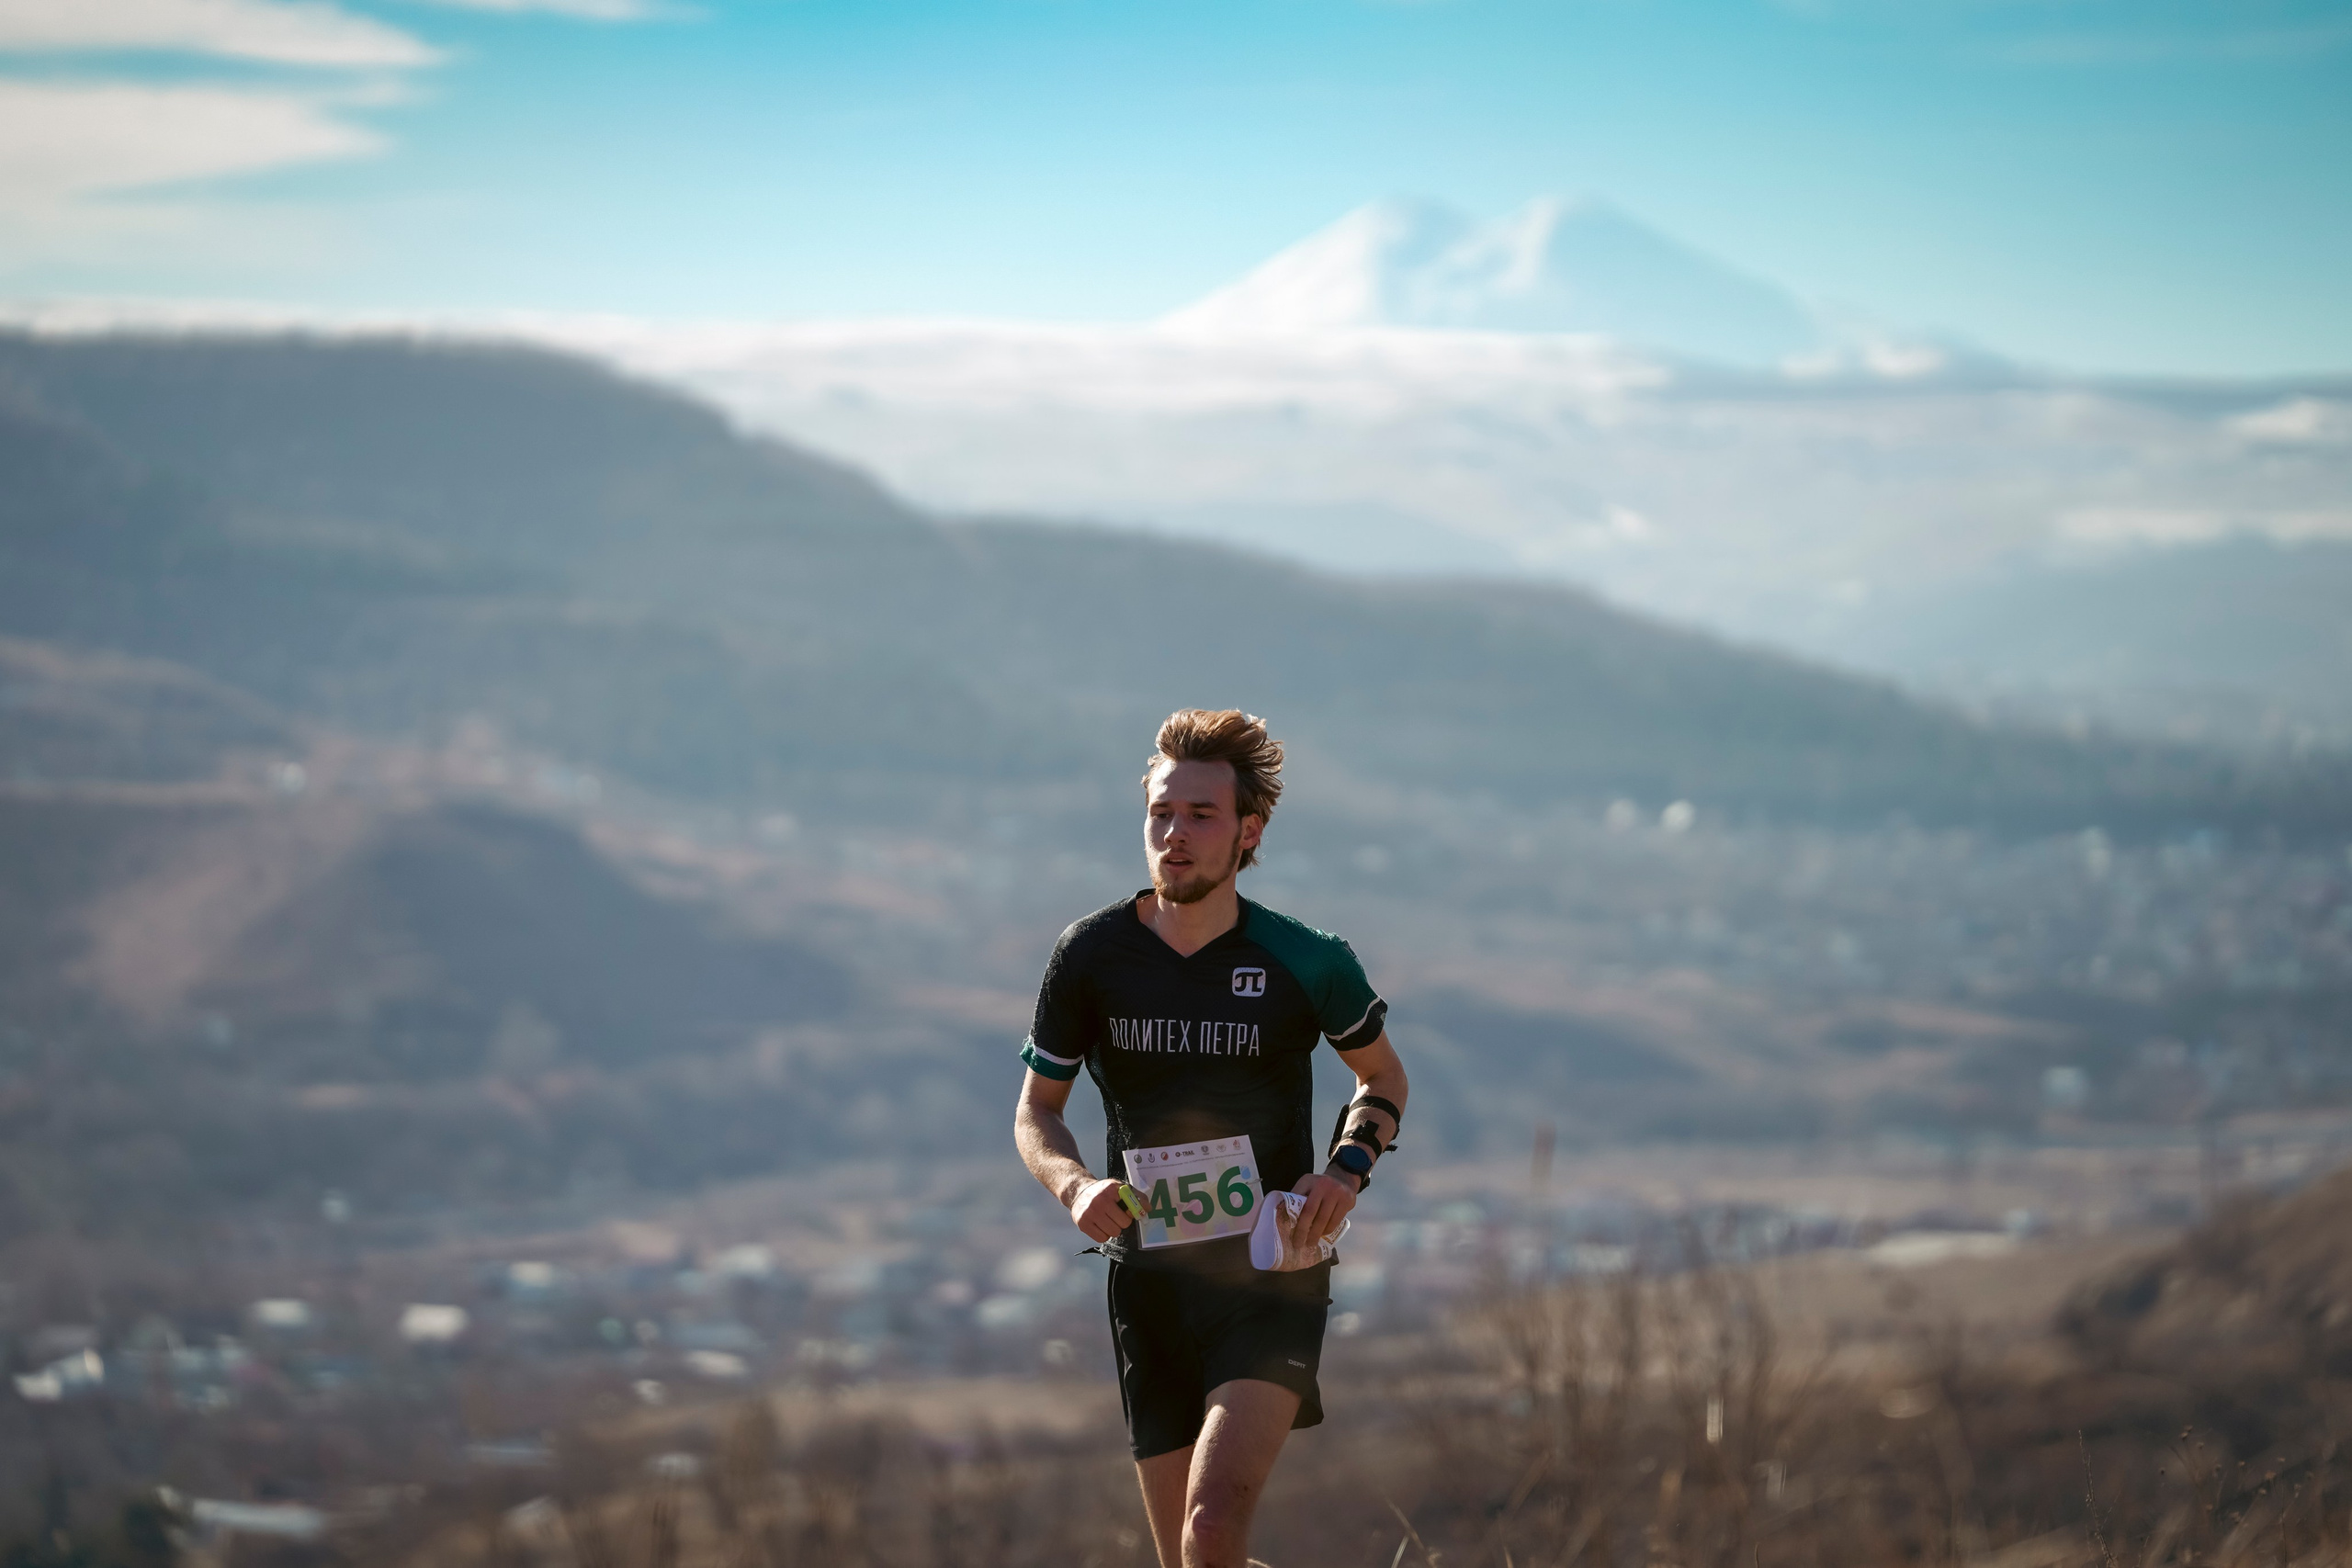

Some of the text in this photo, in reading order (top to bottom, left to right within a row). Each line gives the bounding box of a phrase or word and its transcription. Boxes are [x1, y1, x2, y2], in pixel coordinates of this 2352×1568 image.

[1109, 1017, 1260, 1056] ПОЛИТЕХ ПЕТРА
[1148, 1166, 1254, 1228] 456
